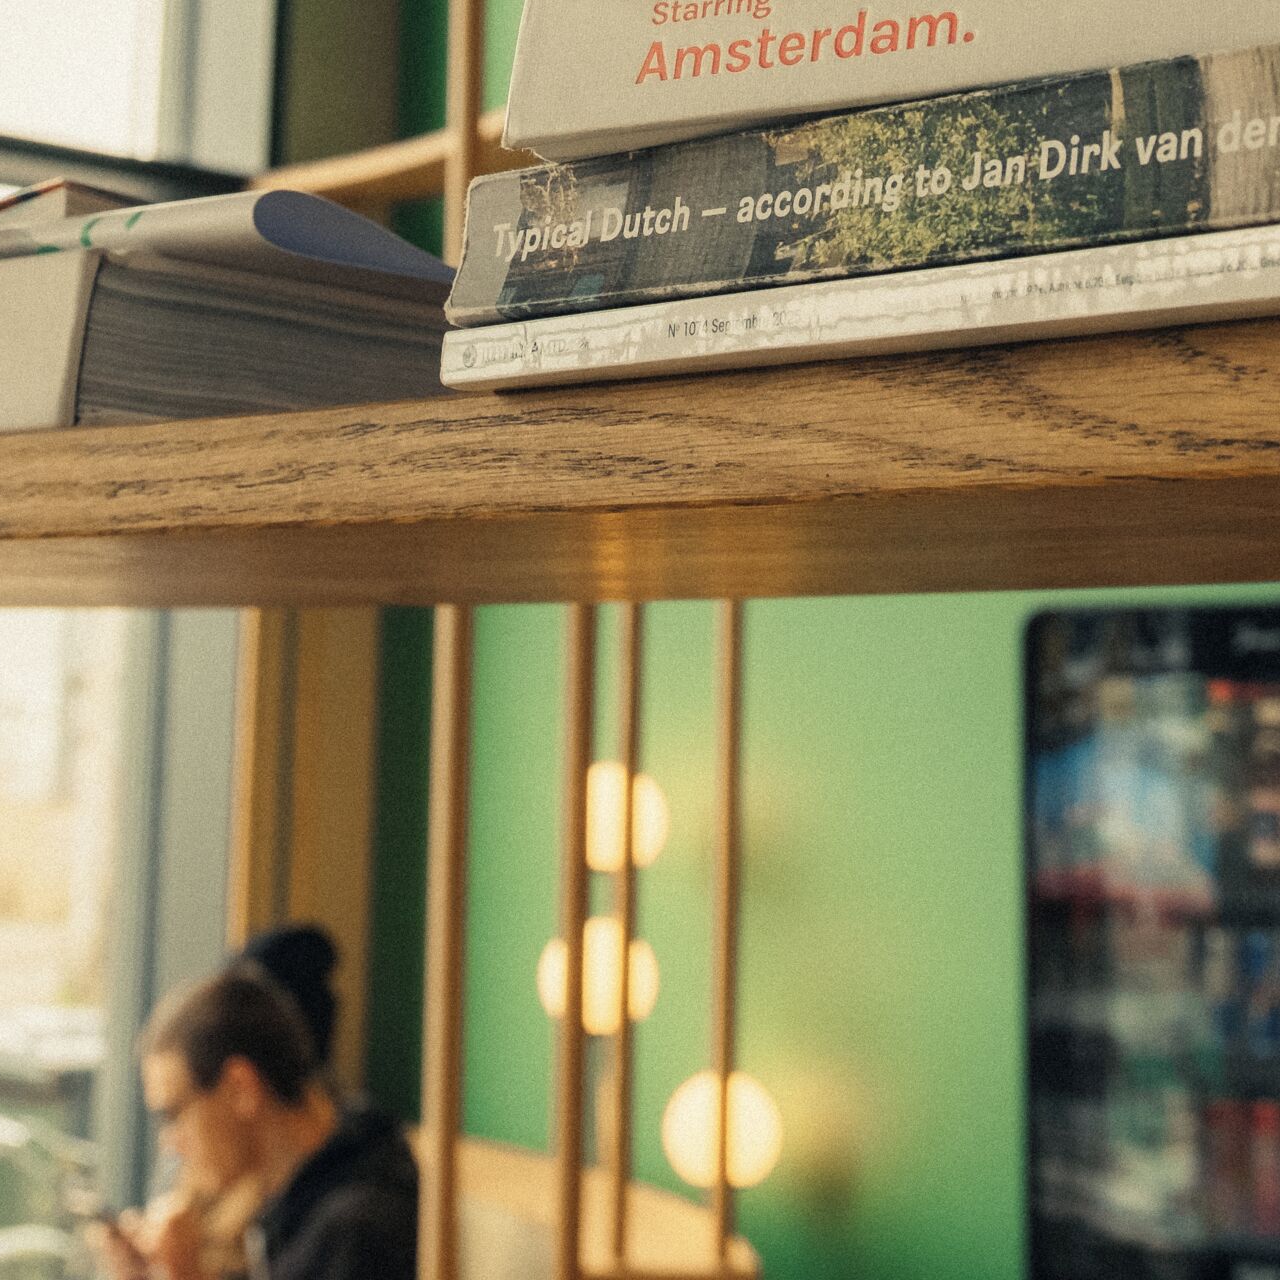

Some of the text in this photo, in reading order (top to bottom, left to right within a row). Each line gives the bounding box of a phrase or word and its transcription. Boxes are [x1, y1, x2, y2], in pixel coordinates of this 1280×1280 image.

[634, 7, 977, 85] Amsterdam.
[492, 219, 592, 264] Typical
[599, 195, 691, 244] Dutch
[736, 168, 904, 224] according
[915, 166, 952, 198] to
[1037, 132, 1123, 182] Dirk
[1134, 124, 1204, 167] van
